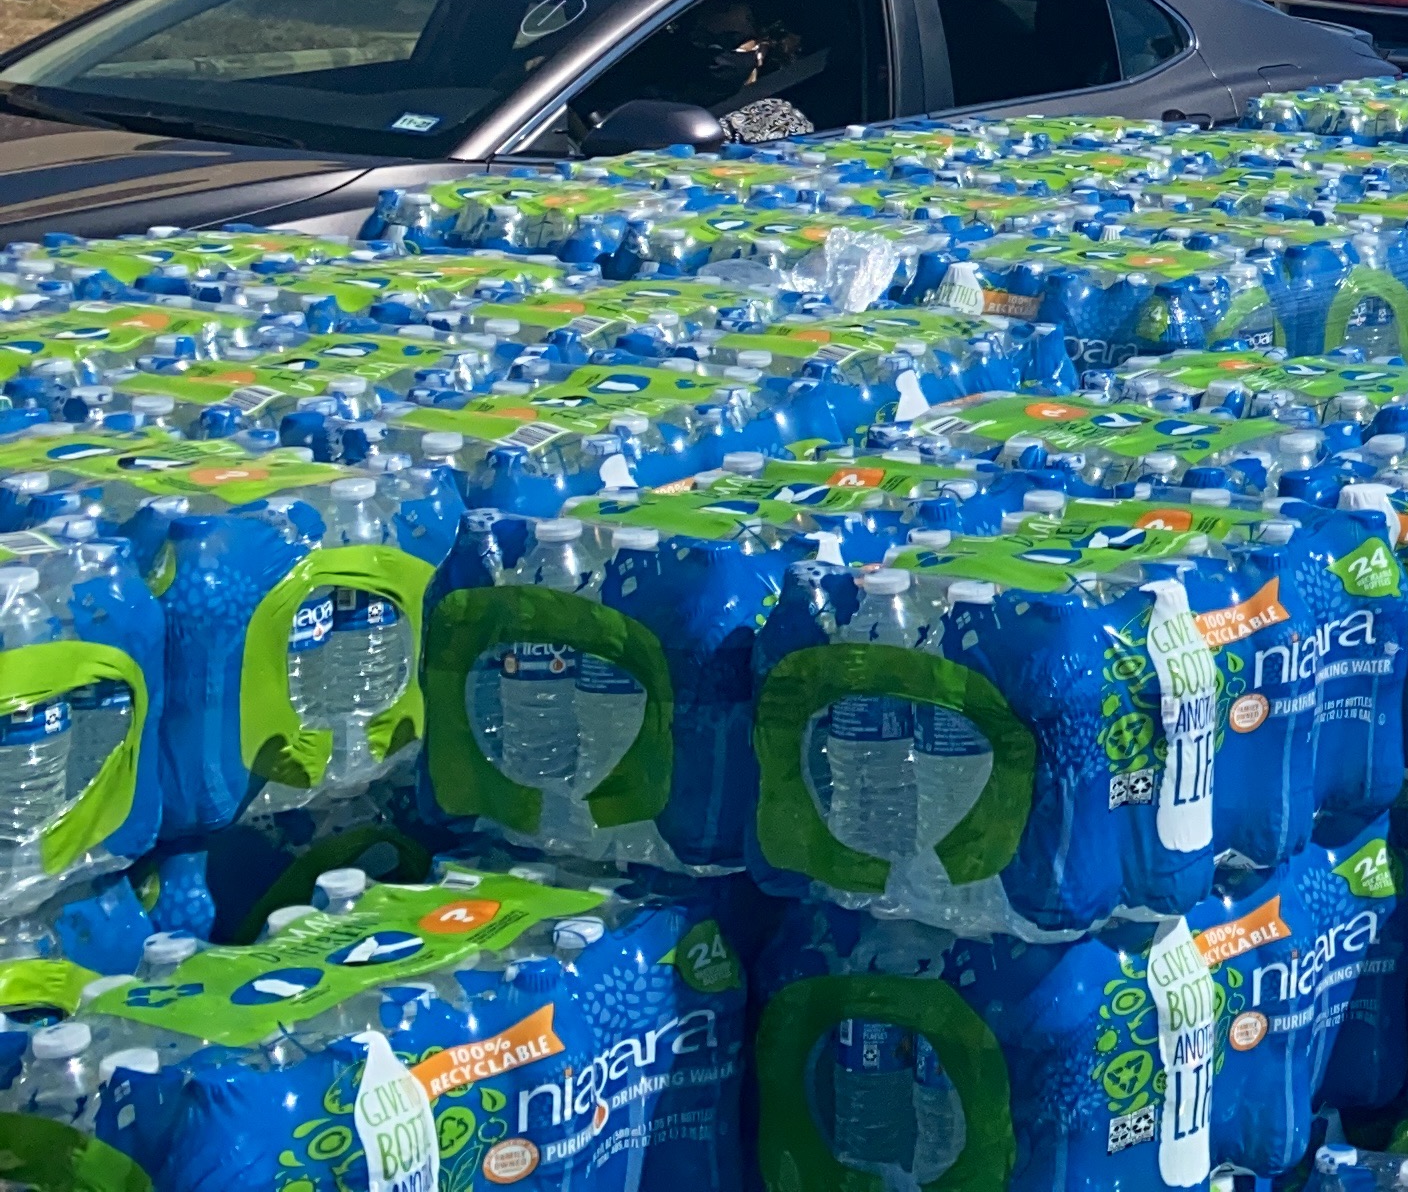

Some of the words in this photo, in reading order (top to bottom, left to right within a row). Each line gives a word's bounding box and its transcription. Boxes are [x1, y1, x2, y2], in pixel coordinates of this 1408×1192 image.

[1348, 547, 1389, 582] 24
[1203, 609, 1245, 630] 100%
[1205, 605, 1280, 646] CYCLABLE
[1166, 648, 1215, 699] BOTT
[1351, 658, 1392, 674] WATER
[1204, 923, 1246, 948] 100%
[687, 941, 728, 972] 24
[1356, 958, 1396, 978] WATER
[1166, 973, 1213, 1034] BOTT
[430, 1034, 551, 1096] RECYCLABLE
[450, 1038, 511, 1068] 100%
[517, 1008, 718, 1137] niagara
[611, 1071, 684, 1109] DRINKING
